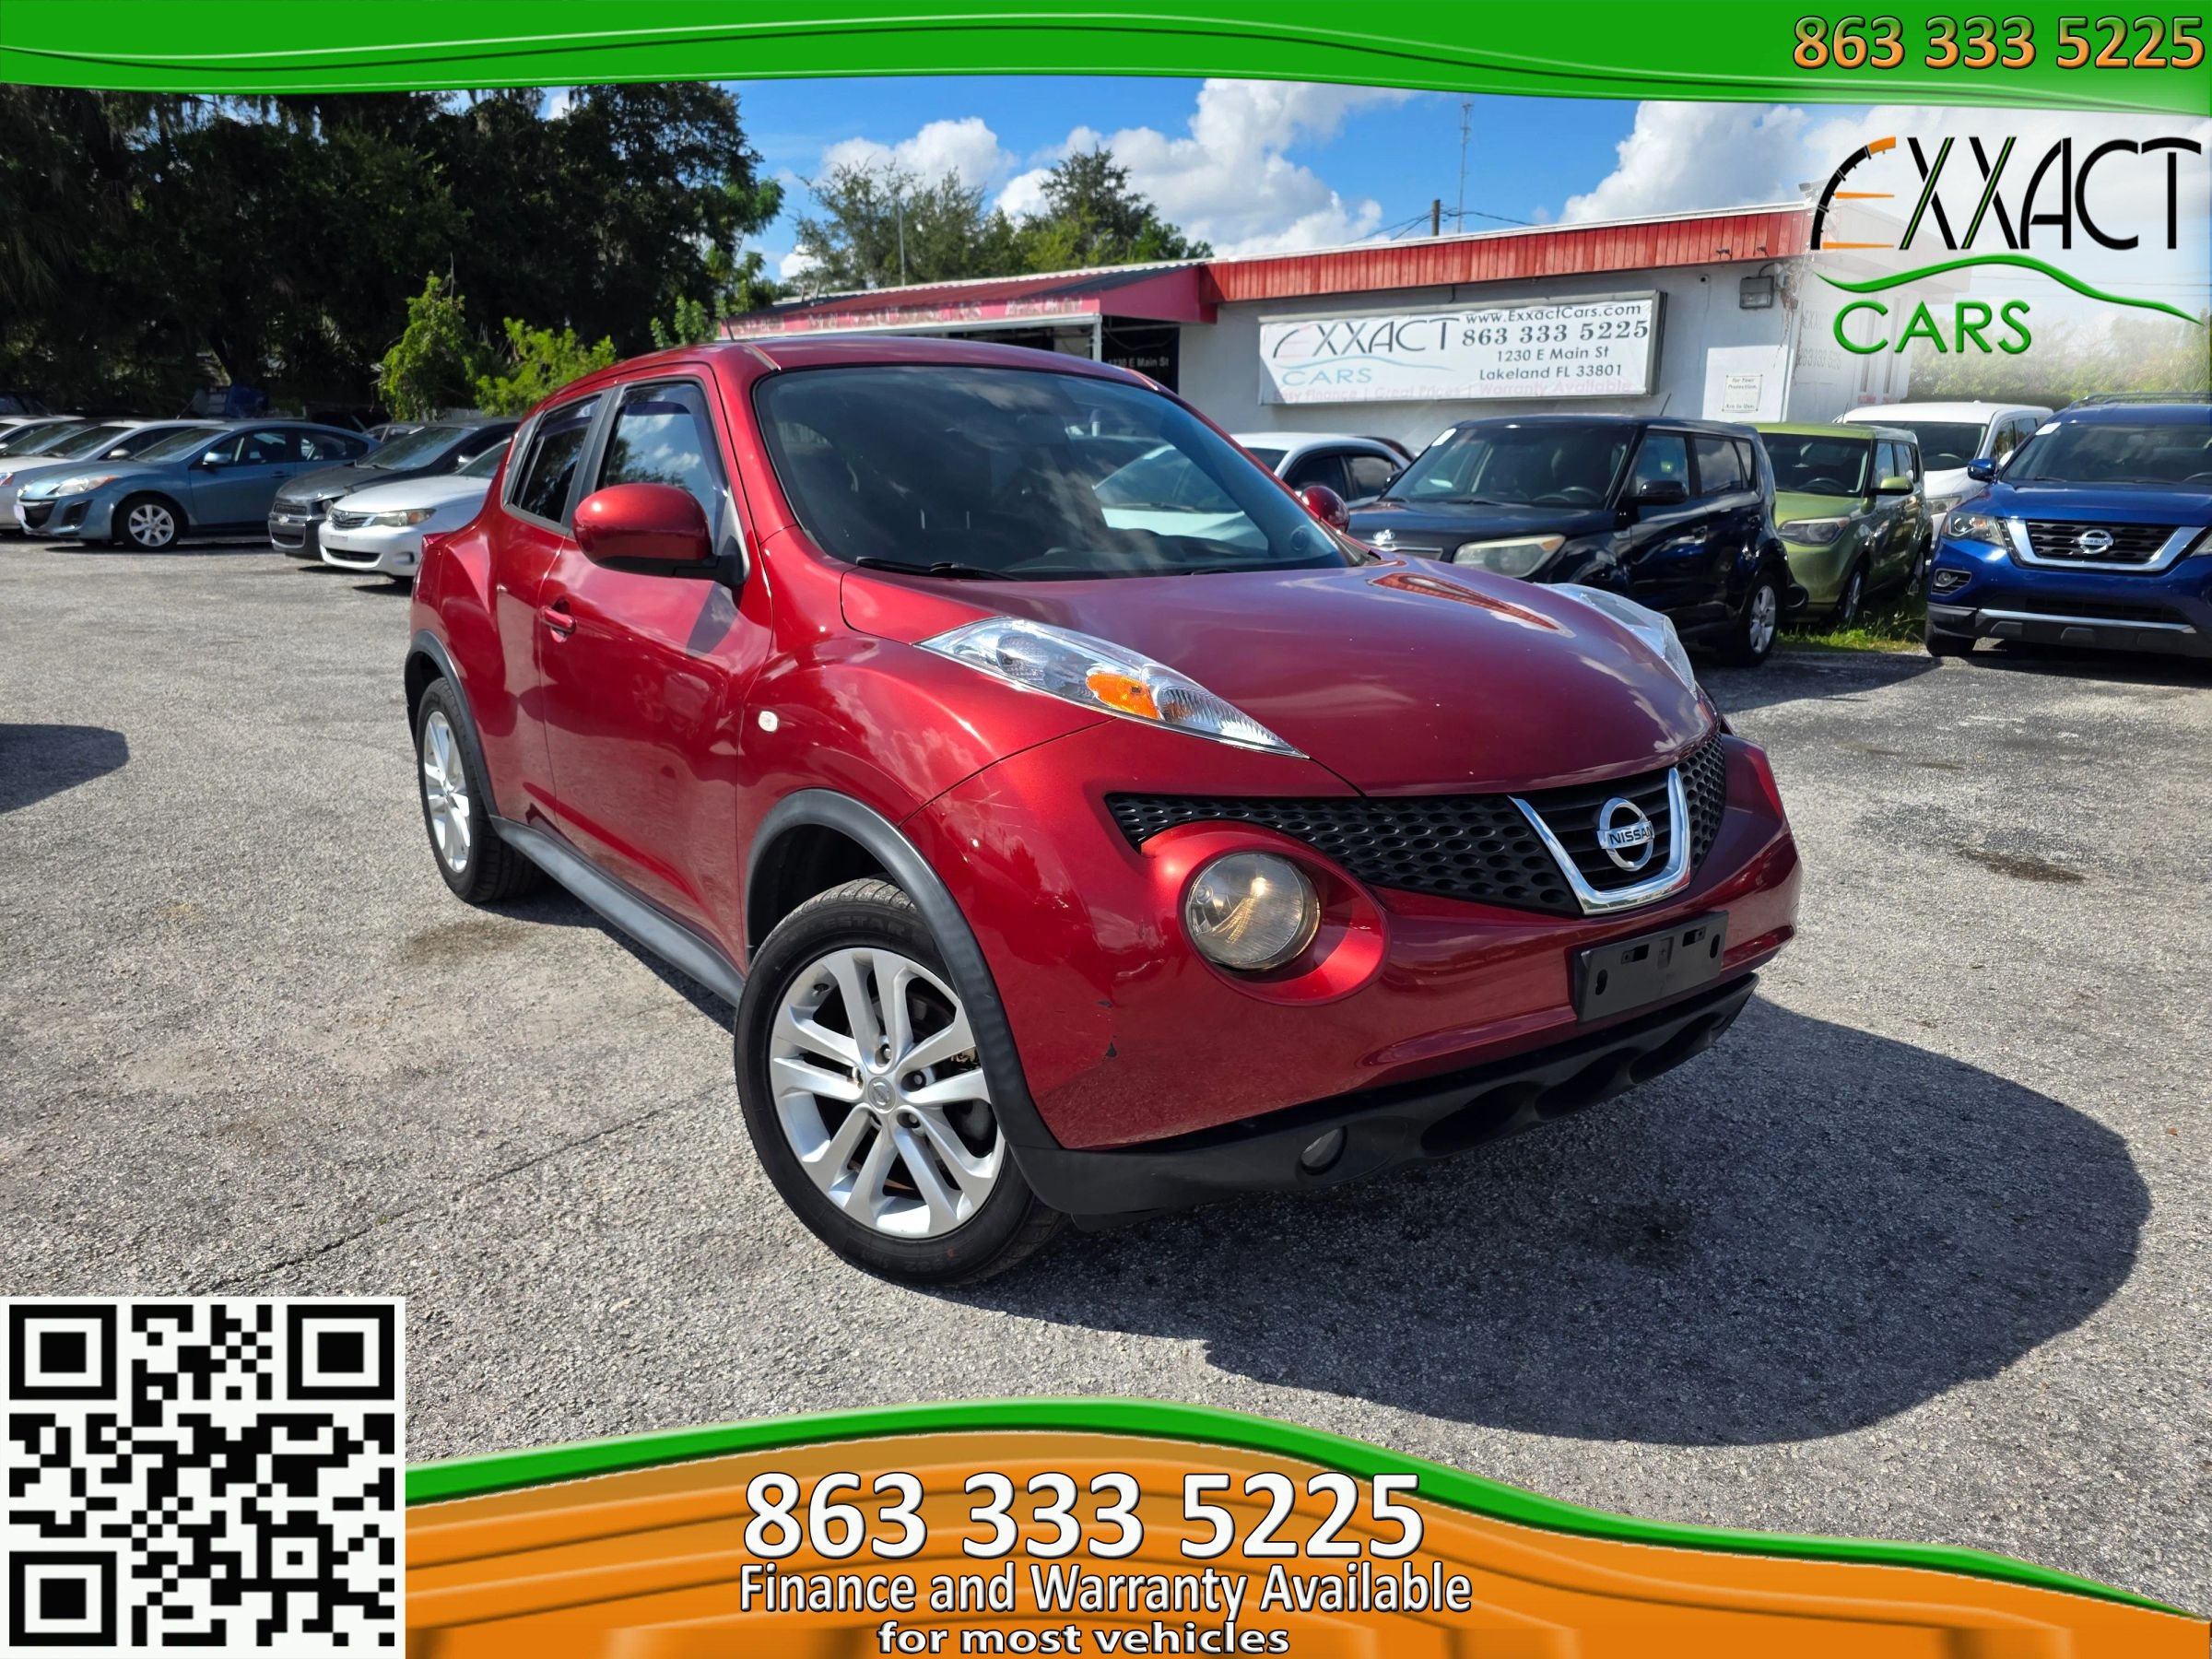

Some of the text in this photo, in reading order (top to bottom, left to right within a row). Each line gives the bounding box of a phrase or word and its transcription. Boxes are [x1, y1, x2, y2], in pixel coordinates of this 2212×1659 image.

[1465, 304, 1641, 324] www.ExxactCars.com
[1272, 317, 1460, 359] EXXACT
[1462, 320, 1648, 347] 863 333 5225
[1497, 346, 1609, 362] 1230 E Main St
[1281, 368, 1372, 387] CARS
[1479, 364, 1622, 381] Lakeland FL 33801
[1608, 825, 1653, 845] NISSAN
